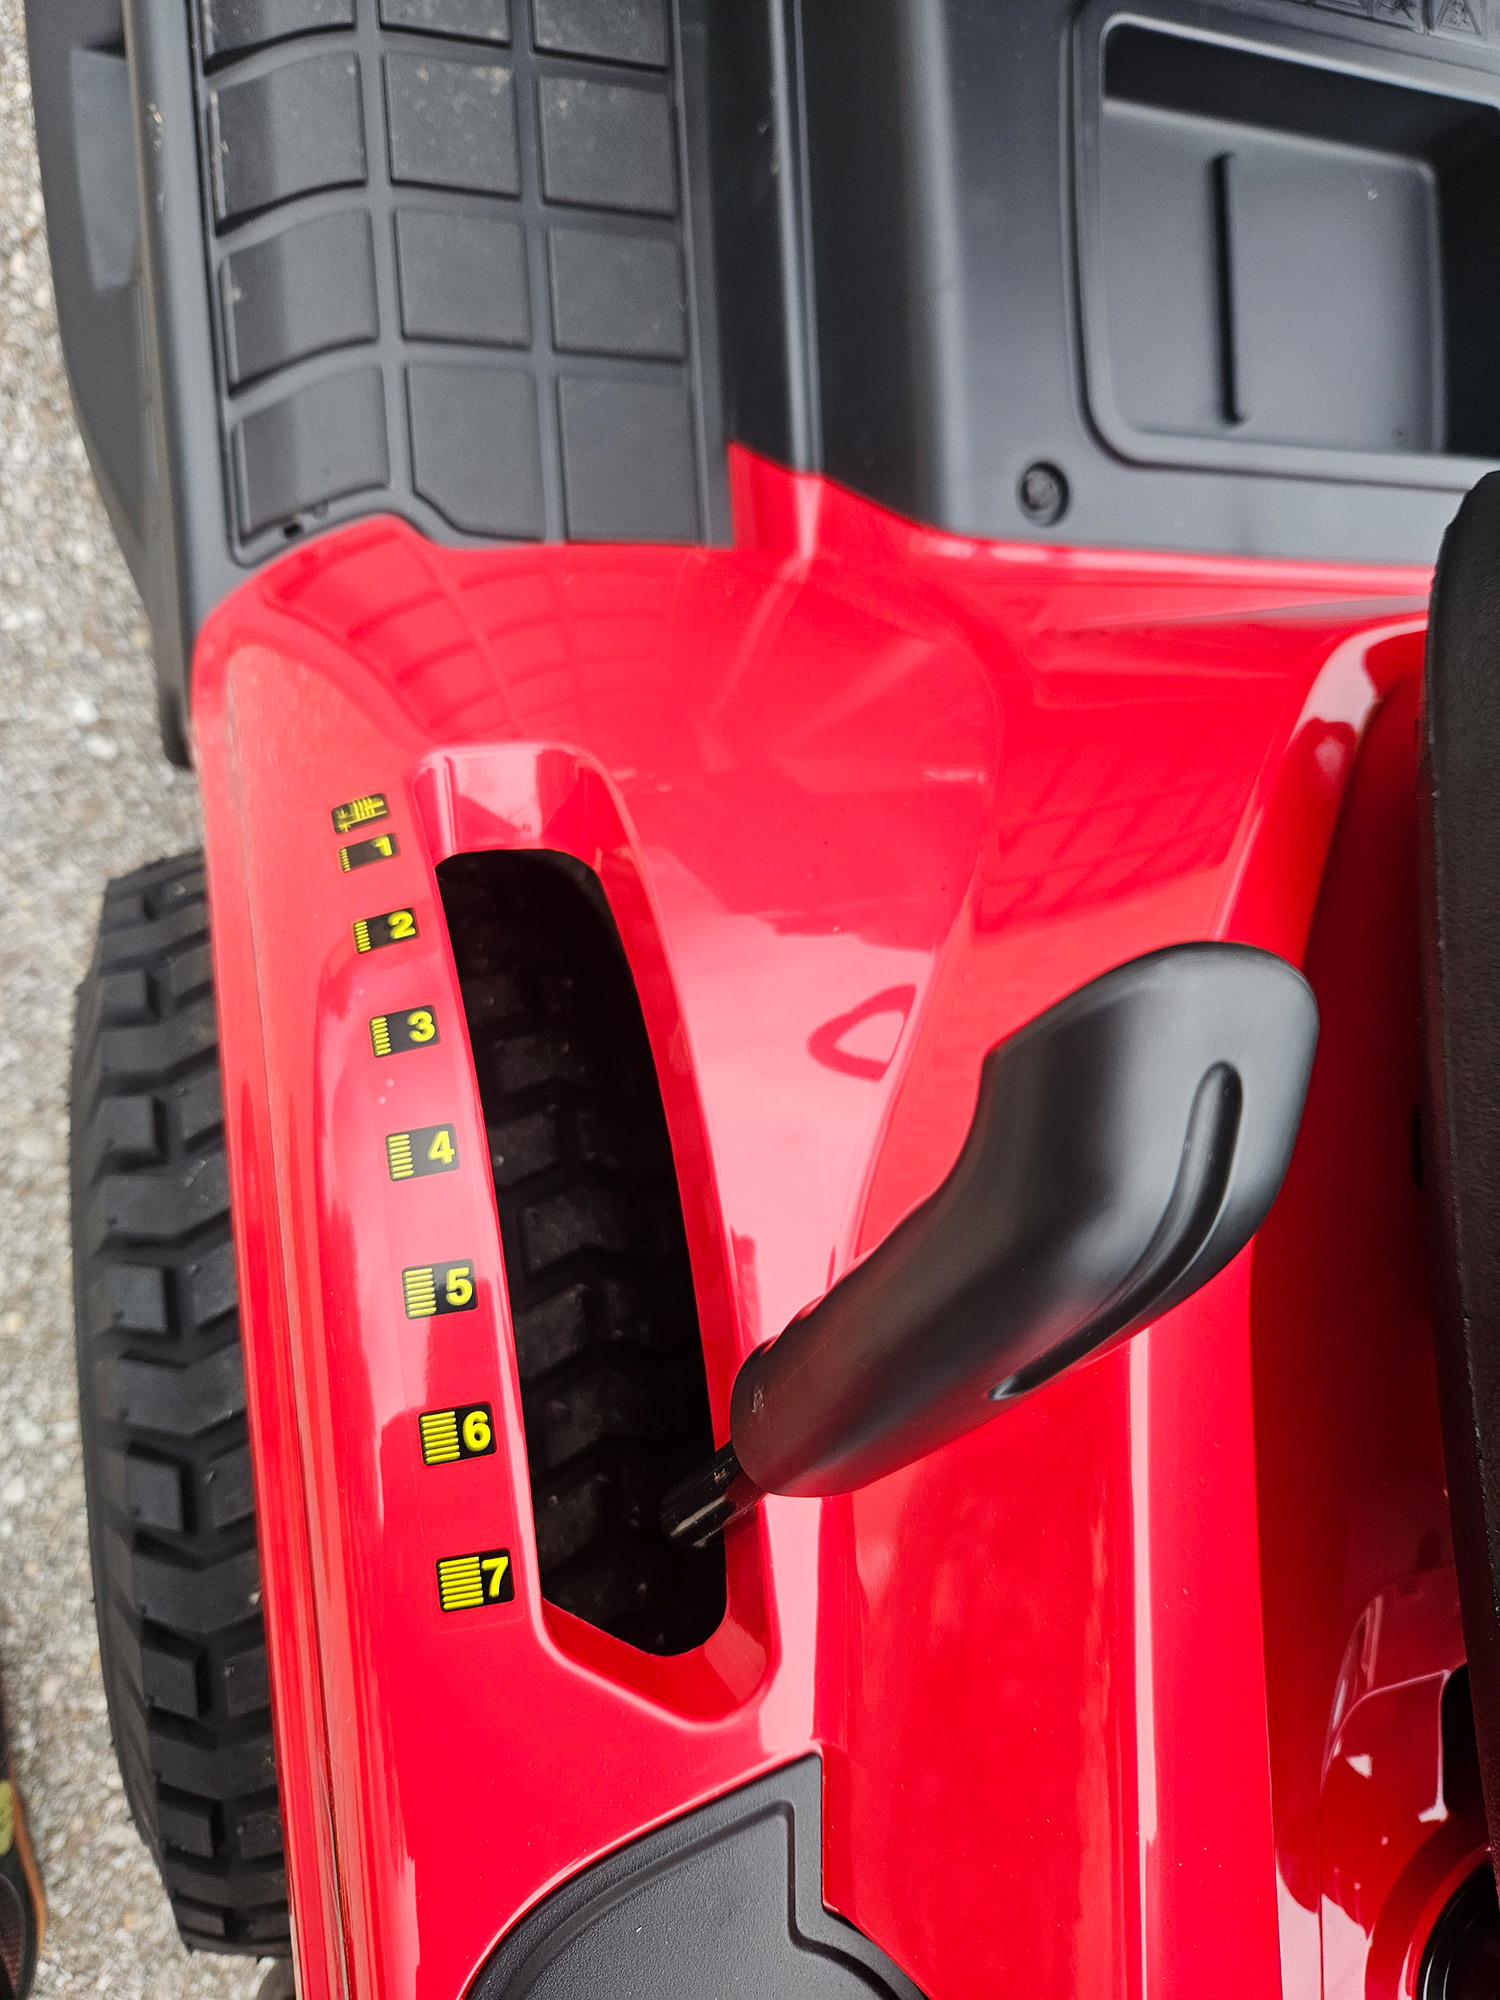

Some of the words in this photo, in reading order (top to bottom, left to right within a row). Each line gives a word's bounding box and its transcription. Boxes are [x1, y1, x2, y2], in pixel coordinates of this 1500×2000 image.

[371, 835, 393, 857] 1
[388, 910, 416, 940] 2
[407, 1010, 436, 1043] 3
[428, 1130, 455, 1164] 4
[446, 1266, 473, 1308] 5
[462, 1410, 491, 1453] 6
[479, 1555, 509, 1599] 7
